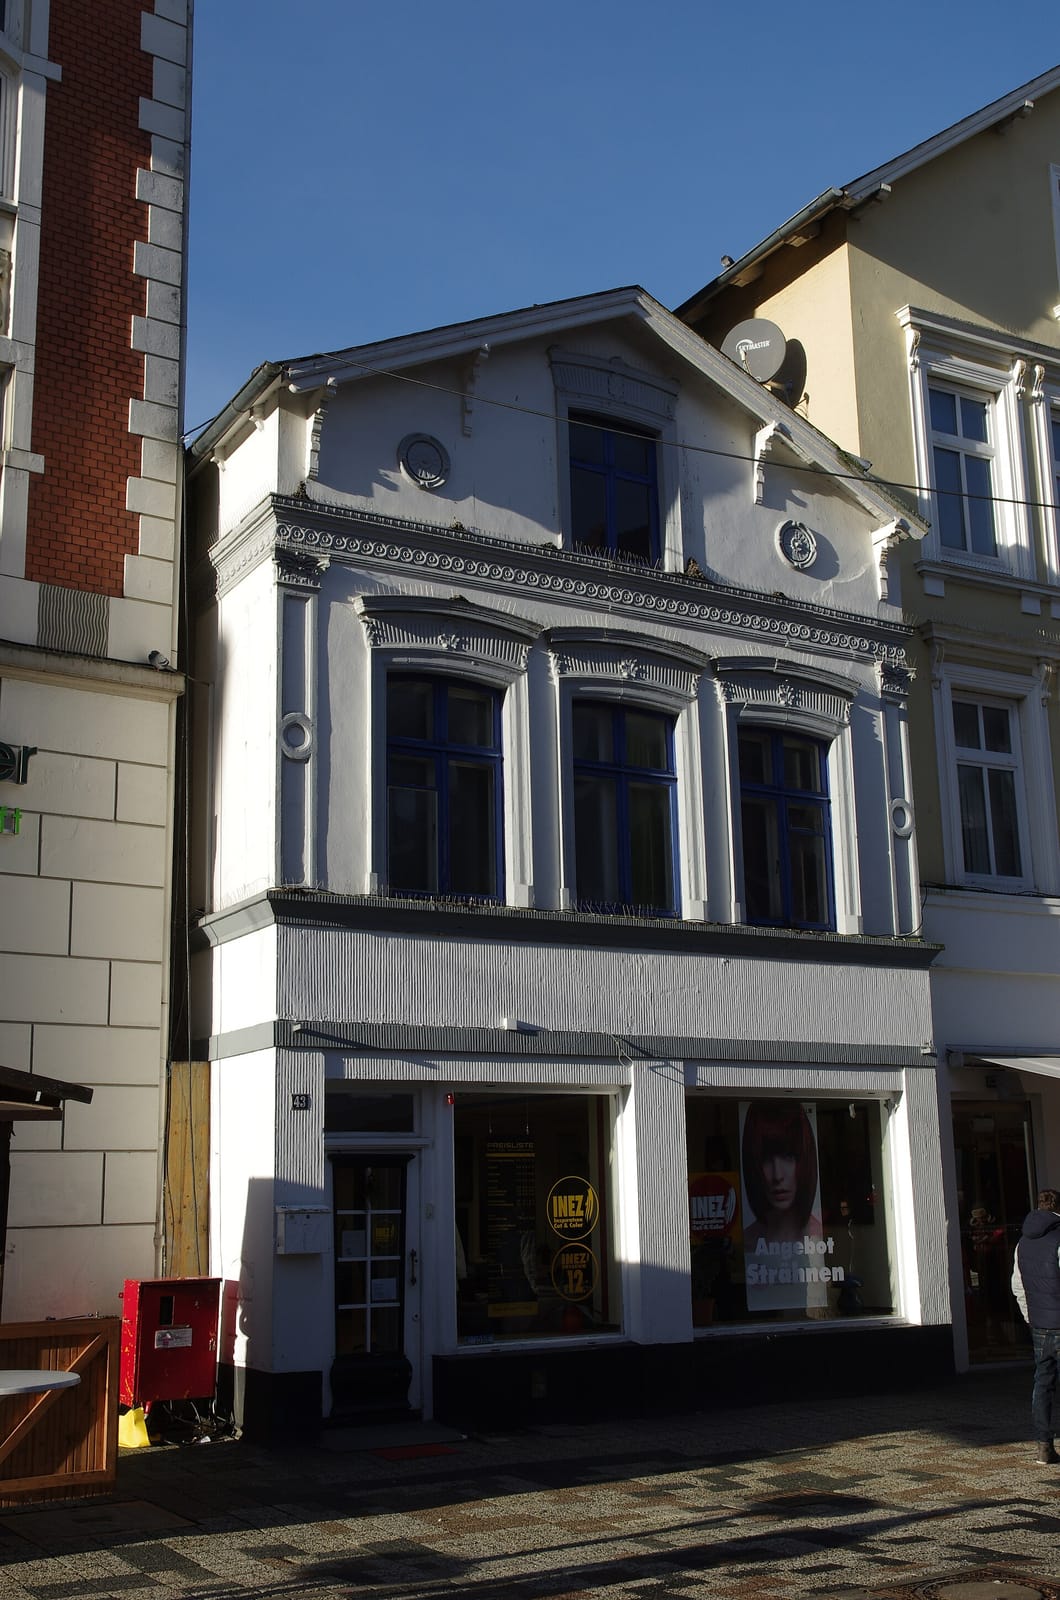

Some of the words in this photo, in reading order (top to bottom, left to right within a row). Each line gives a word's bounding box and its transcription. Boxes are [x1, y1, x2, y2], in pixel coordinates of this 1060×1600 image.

[293, 1095, 307, 1108] 43
[552, 1195, 585, 1218] INEZ
[690, 1196, 725, 1218] INEZ
[561, 1252, 587, 1265] INEZ
[756, 1236, 835, 1260] Angebot
[567, 1270, 584, 1294] 12
[747, 1261, 845, 1284] Strähnen
